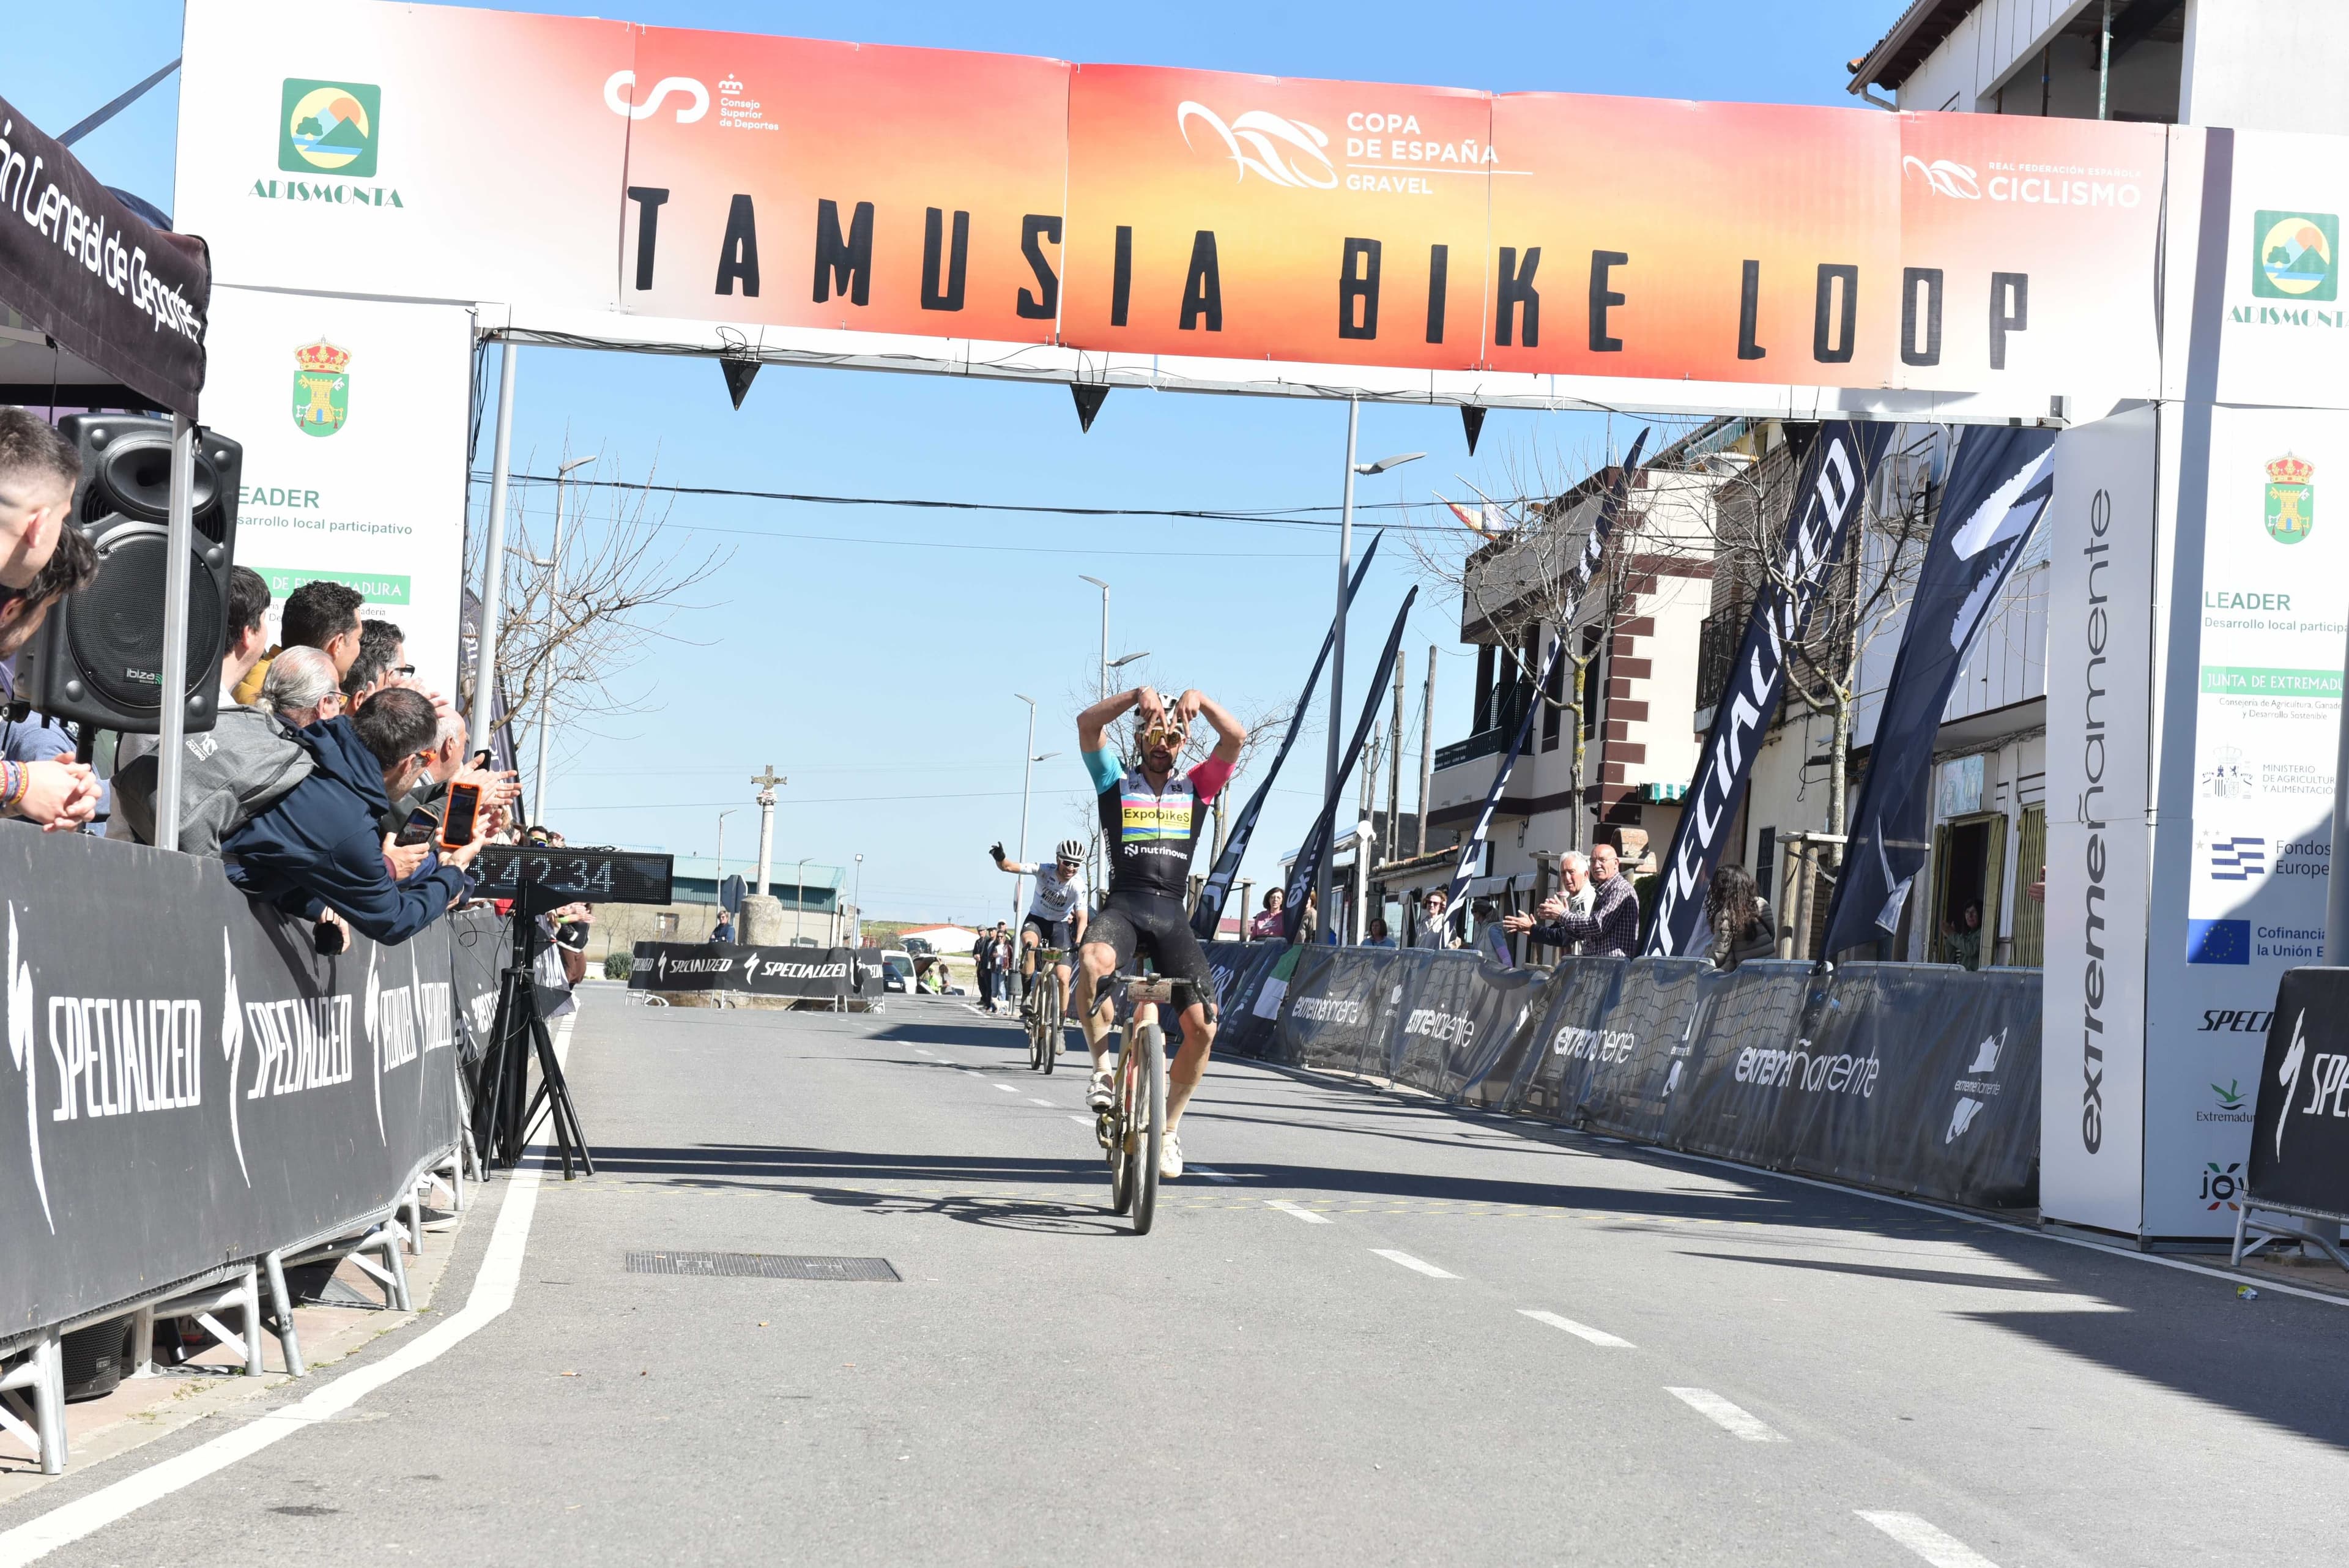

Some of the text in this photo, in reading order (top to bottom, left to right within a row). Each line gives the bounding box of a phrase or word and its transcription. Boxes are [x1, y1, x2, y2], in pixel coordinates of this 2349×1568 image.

[721, 98, 760, 110] Consejo
[721, 108, 763, 119] Superior
[719, 118, 779, 130] de Deportes
[1347, 111, 1420, 135] COPA
[1347, 138, 1499, 164] DE ESPAÑA
[1989, 162, 2141, 178] REAL FEDERACIÓN ESPAÑOLA
[1346, 174, 1433, 195] GRAVEL
[1988, 176, 2140, 208] CICLISMO
[248, 178, 404, 209] ADISMONTA
[627, 186, 2028, 370] TAMUSIA BIKE LOOP
[105, 230, 128, 296] de
[130, 246, 201, 344] Deportes
[294, 518, 325, 529] local
[330, 521, 412, 535] participativo
[272, 576, 289, 590] DE
[2205, 591, 2291, 611] LEADER
[2205, 617, 2265, 629] Desarrollo
[2268, 619, 2296, 631] local
[127, 667, 155, 680] ibiza
[2207, 674, 2247, 688] JUNTA
[2252, 675, 2266, 688] DE
[2249, 710, 2288, 719] Desarrollo
[2290, 712, 2327, 720] Sostenible
[2263, 764, 2315, 773] MINISTERIO
[1140, 846, 1188, 860] nutrinovex
[2276, 840, 2331, 855] Fondos
[2257, 944, 2269, 956] la
[2273, 945, 2312, 957] Unión
[669, 959, 733, 973] SPECIALIZED
[761, 962, 847, 979] SPECIALIZED
[245, 994, 352, 1100] SPECIALIZED
[48, 996, 201, 1121] SPECIALIZED
